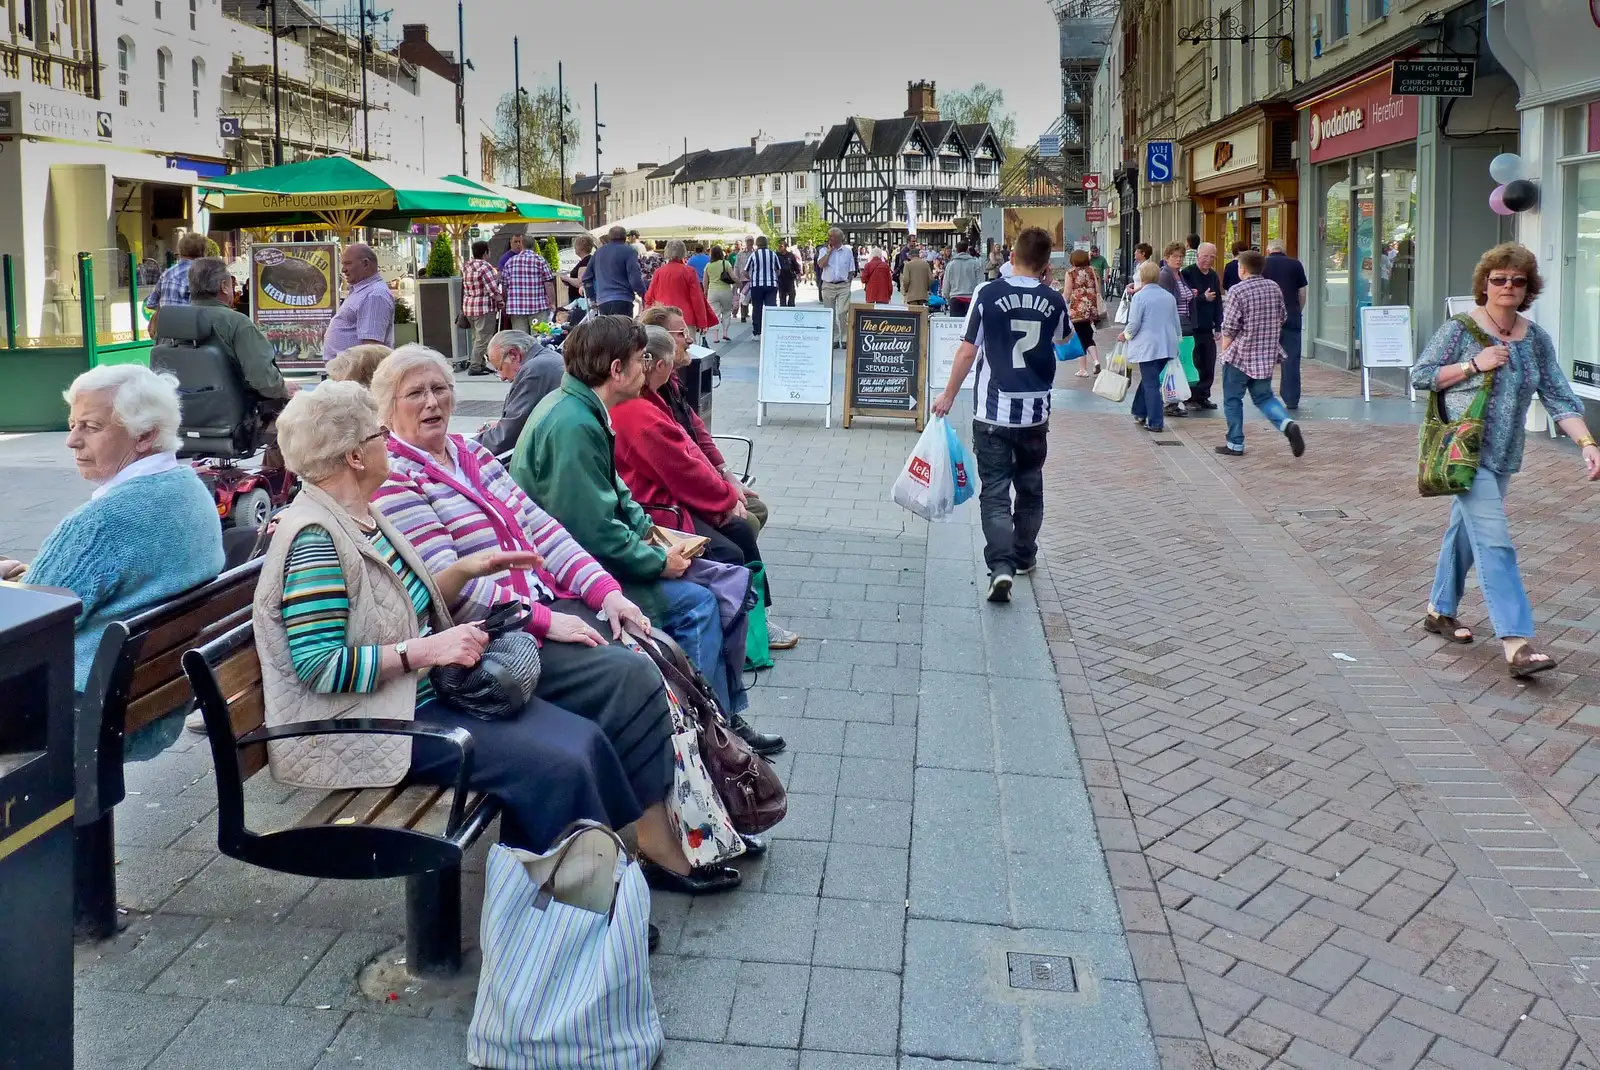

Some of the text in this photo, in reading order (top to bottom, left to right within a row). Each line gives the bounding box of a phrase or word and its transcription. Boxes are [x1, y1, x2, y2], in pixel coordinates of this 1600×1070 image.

[1321, 95, 1404, 139] vodafone Hereford
[222, 121, 235, 134] O2
[1151, 145, 1168, 154] WH
[1151, 153, 1169, 180] S
[262, 193, 382, 208] CAPPUCCINO PIAZZA
[291, 247, 329, 271] WANTED
[264, 283, 317, 306] KEEN BEANS!
[994, 293, 1056, 318] TIMMINS
[862, 319, 912, 334] The Grapes
[861, 334, 912, 354] Sunday
[1010, 319, 1042, 369] 7
[872, 351, 905, 364] Roast
[865, 364, 889, 373] SERVED
[1574, 365, 1589, 379] Join
[789, 391, 801, 399] £6
